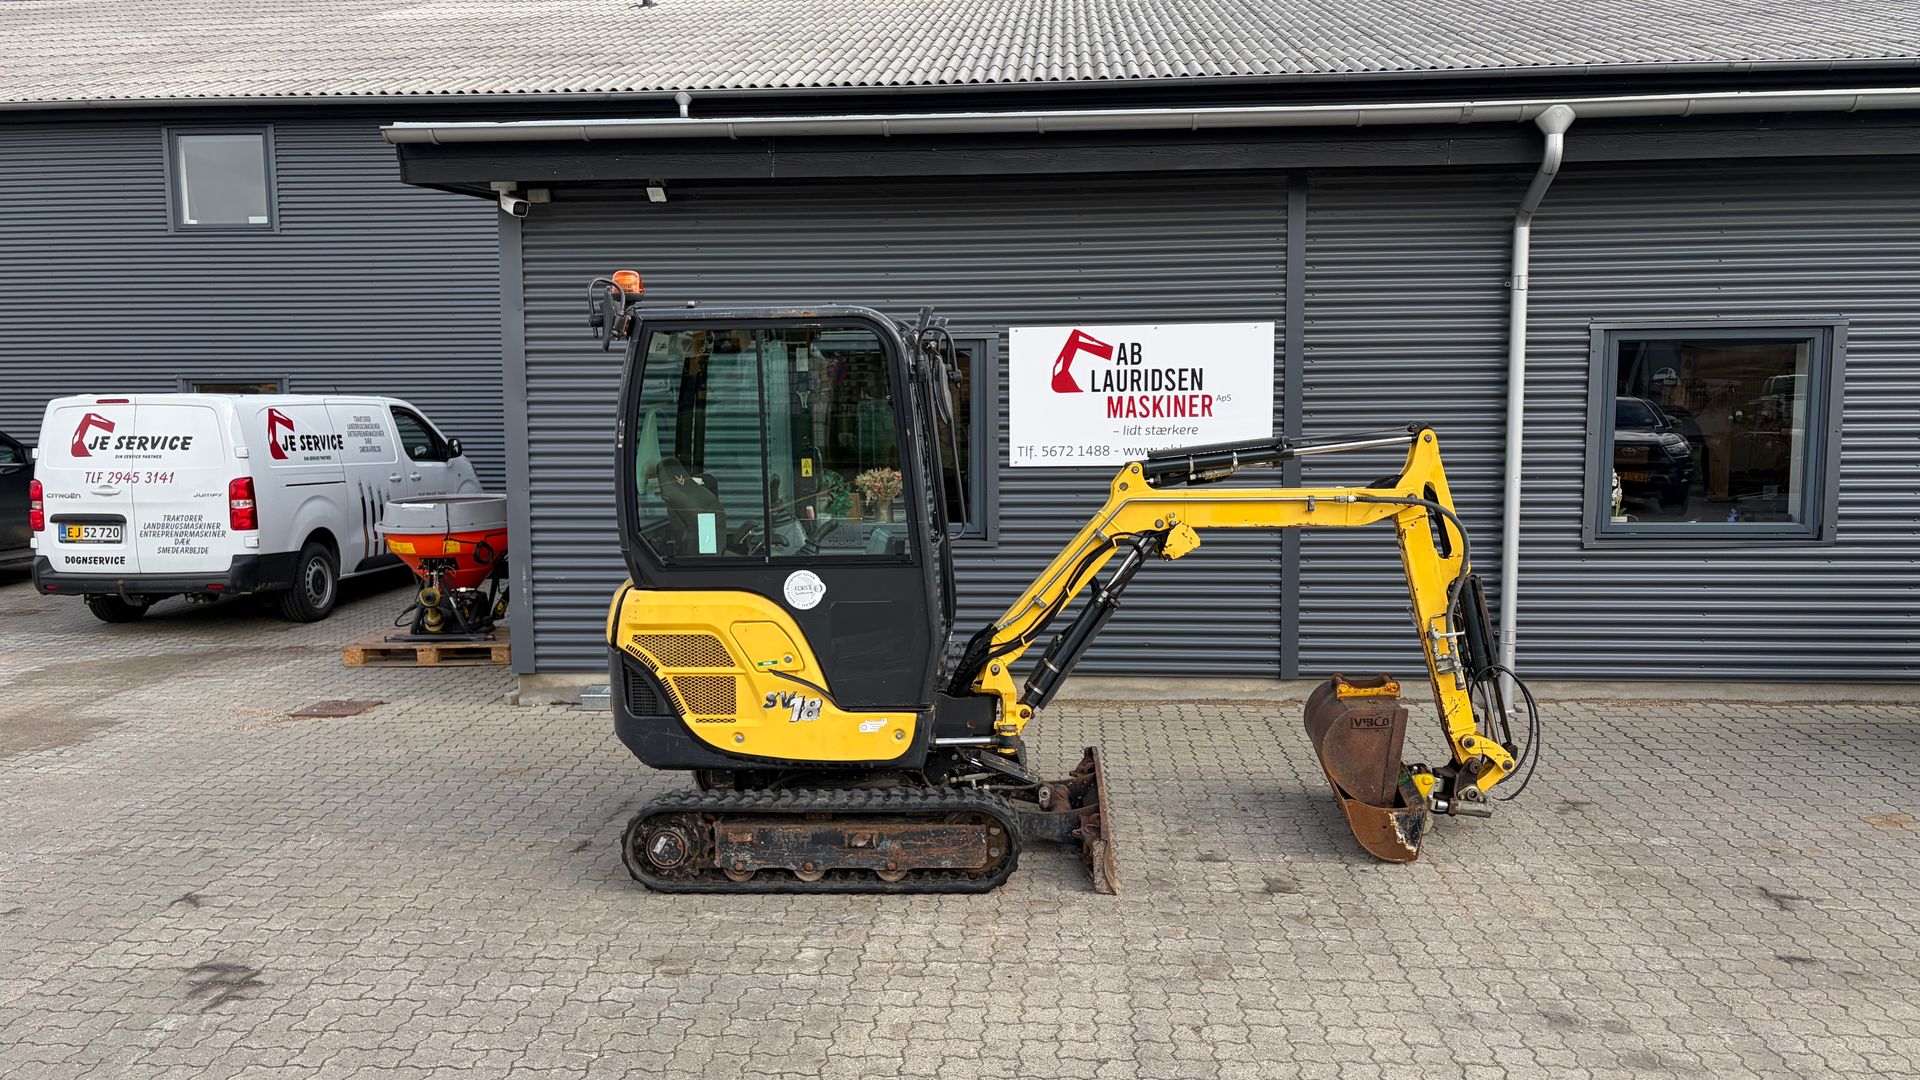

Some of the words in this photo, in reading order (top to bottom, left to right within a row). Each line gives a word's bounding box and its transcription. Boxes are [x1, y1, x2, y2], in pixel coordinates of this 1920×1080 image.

[1116, 342, 1142, 365] AB
[1091, 368, 1204, 393] LAURIDSEN
[1216, 393, 1232, 403] ApS
[1107, 394, 1213, 418] MASKINER
[1123, 424, 1142, 436] lidt
[1145, 424, 1199, 436] stærkere
[88, 436, 111, 451] JE
[114, 435, 193, 452] SERVICE
[282, 434, 297, 452] JE
[300, 434, 344, 452] SERVICE
[1017, 445, 1037, 459] Tlf.
[1041, 445, 1074, 457] 5672
[1078, 445, 1110, 457] 1488
[85, 471, 104, 484] TLF
[107, 471, 140, 485] 2945
[144, 471, 175, 484] 3141
[163, 514, 203, 522] TRAKTORER
[143, 522, 221, 530] LANDBRUGSMASKINER
[67, 527, 81, 538] EJ
[84, 527, 97, 538] 52
[99, 527, 119, 538] 720
[139, 530, 227, 538] ENTREPRENØRMASKINER
[174, 538, 191, 546] DÆK
[157, 546, 209, 555] SMEDEARBEJDE
